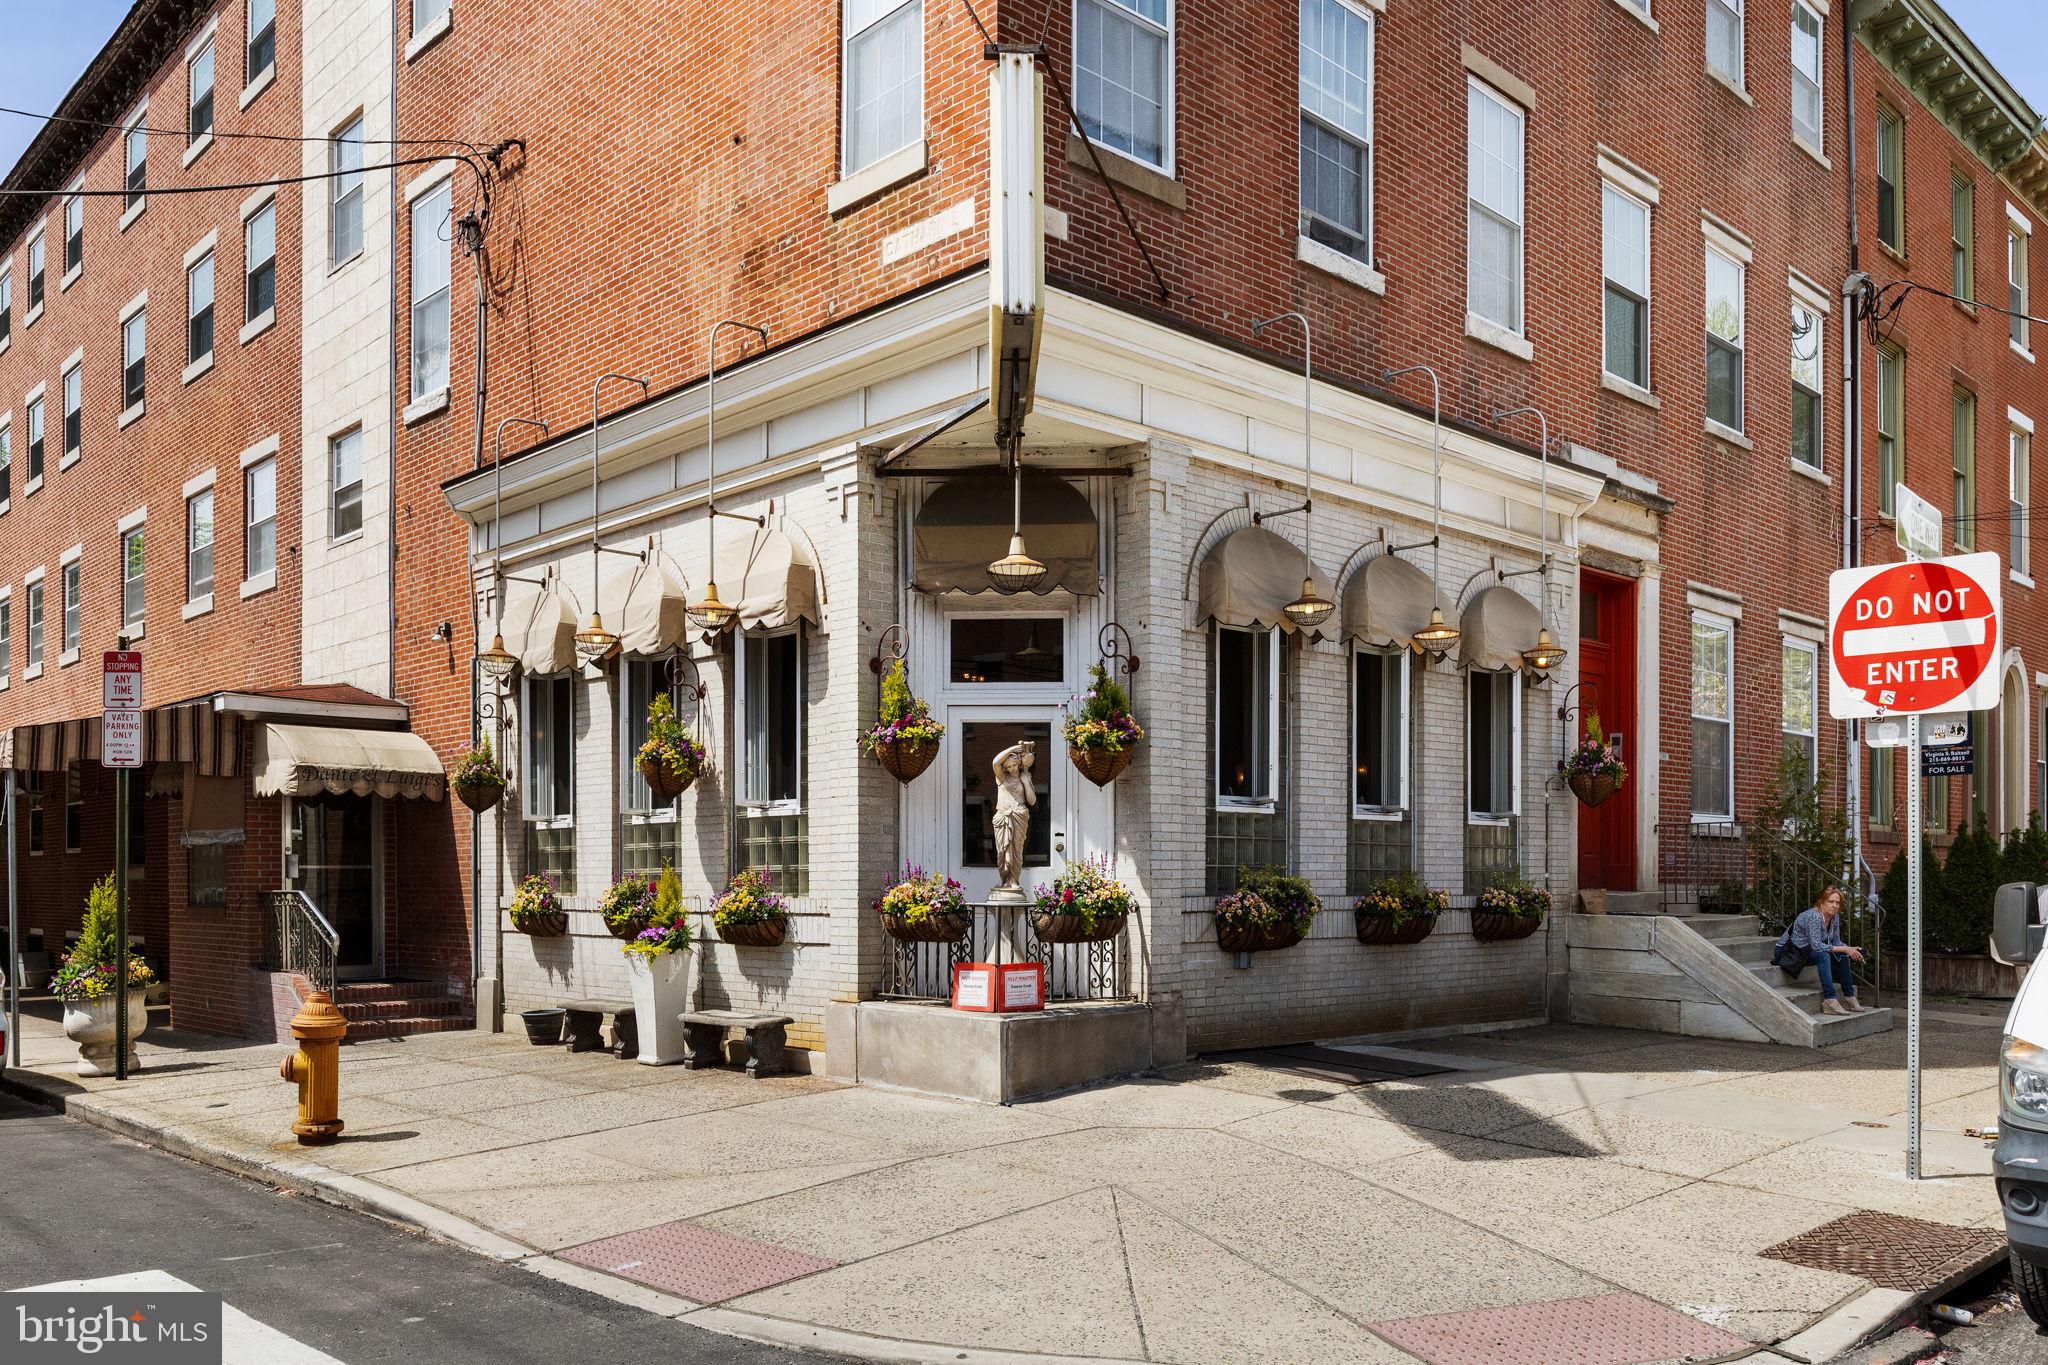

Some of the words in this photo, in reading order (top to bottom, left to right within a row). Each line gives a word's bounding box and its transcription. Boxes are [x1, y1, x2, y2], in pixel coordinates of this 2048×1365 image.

[1911, 512, 1924, 540] ONE
[1924, 519, 1938, 547] WAY
[1856, 596, 1893, 621] DO
[1913, 587, 1971, 615] NOT
[106, 662, 139, 671] STOPPING
[1867, 656, 1959, 685] ENTER
[114, 675, 132, 684] ANY
[113, 685, 133, 695] TIME
[111, 713, 134, 721] VALET
[106, 722, 139, 730] PARKING
[112, 731, 133, 739] ONLY
[302, 765, 357, 781] Dante
[363, 767, 380, 782] &
[386, 769, 440, 791] Luigi's
